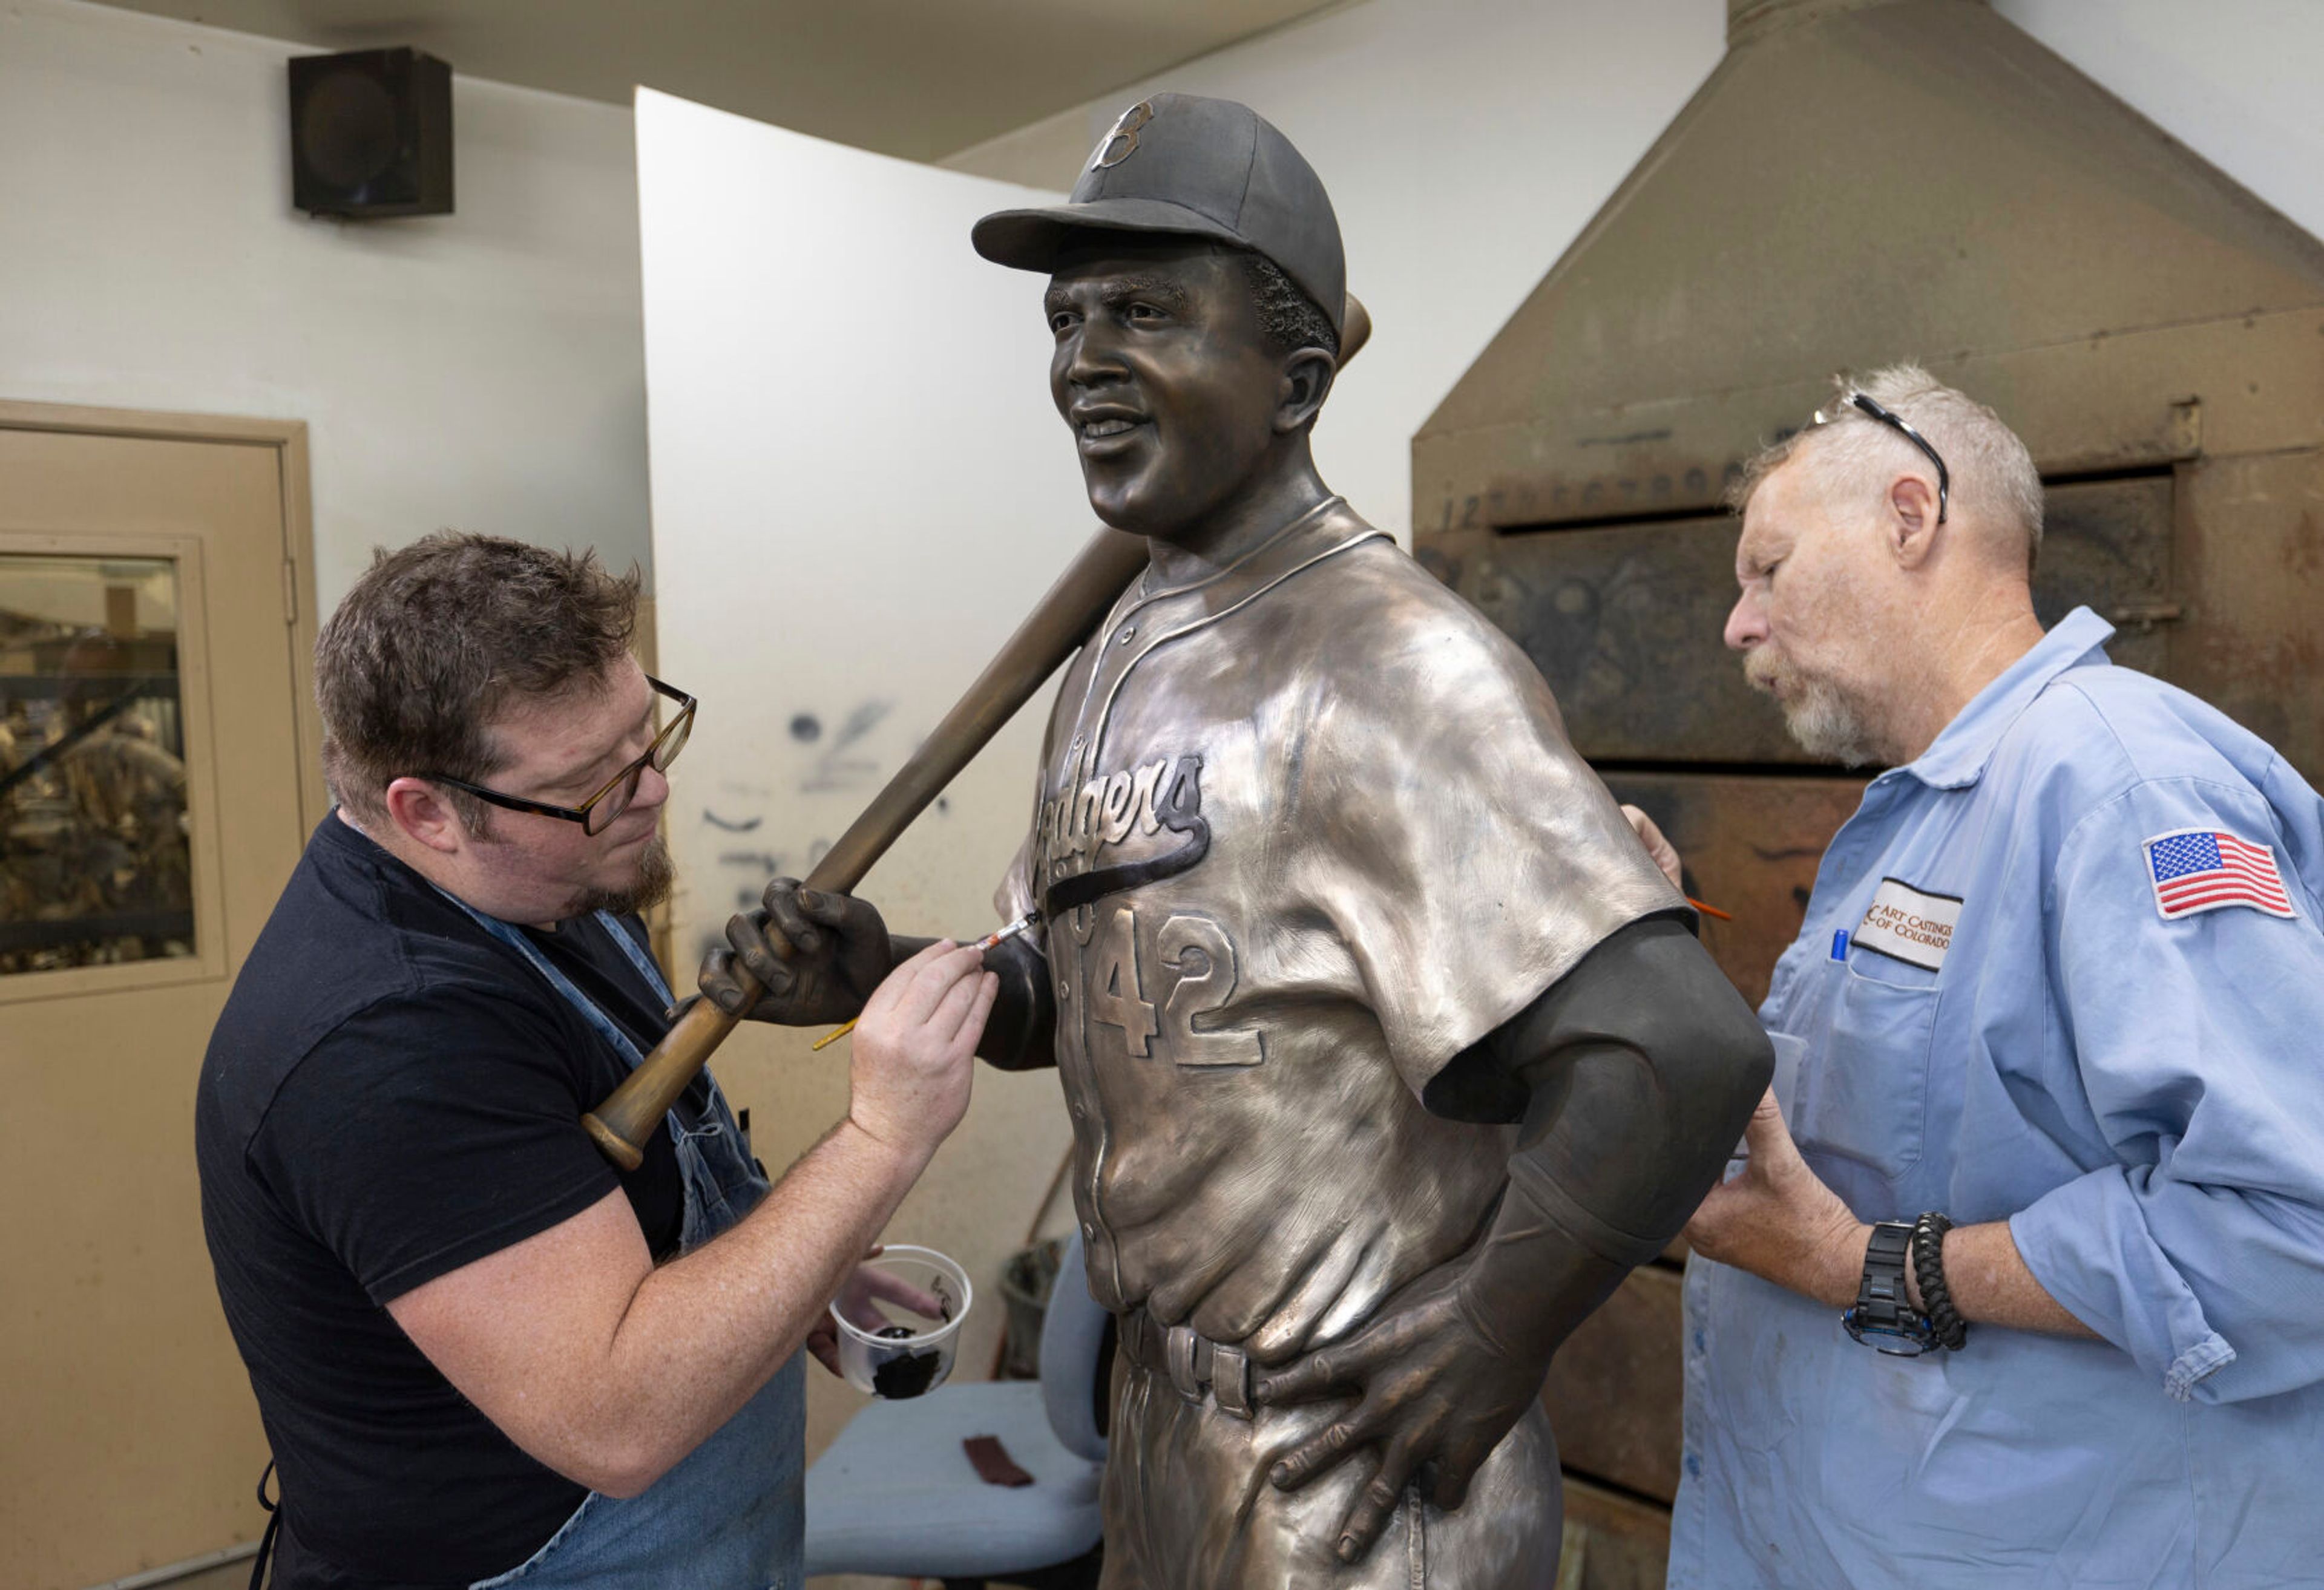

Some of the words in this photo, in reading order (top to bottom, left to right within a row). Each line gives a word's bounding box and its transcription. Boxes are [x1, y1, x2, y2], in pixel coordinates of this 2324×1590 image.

[1091, 101, 1154, 172] B
[1876, 917, 1893, 929] OF
[1895, 924, 1950, 950] COLORADO
[1880, 905, 1907, 921] ART
[1908, 915, 1954, 937] CASTINGS
[1093, 908, 1264, 1066] 42
